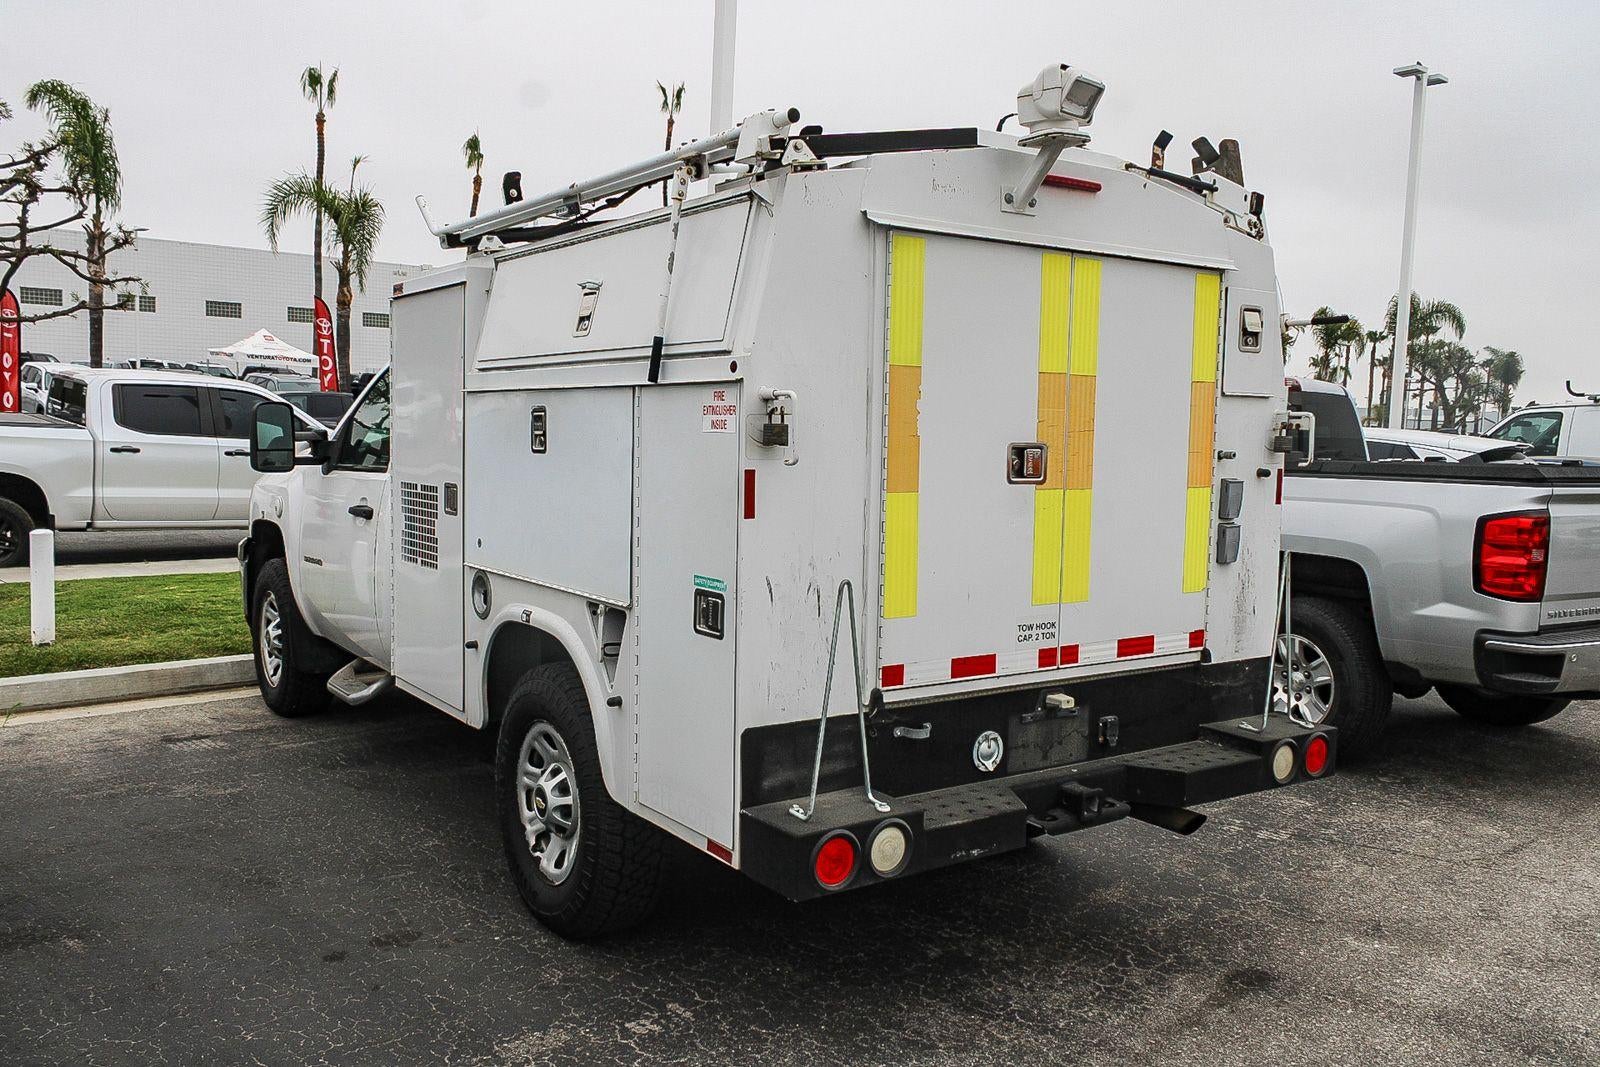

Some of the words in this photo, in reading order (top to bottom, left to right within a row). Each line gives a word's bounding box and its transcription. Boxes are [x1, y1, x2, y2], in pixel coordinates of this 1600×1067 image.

[246, 354, 312, 363] VENTURATOYOTA.COM
[320, 339, 333, 389] TOY
[2, 332, 14, 409] TOYO
[713, 390, 726, 401] FIRE
[703, 405, 737, 416] EXTINGUISHER
[711, 419, 728, 430] INSIDE
[1017, 623, 1034, 632] TOW
[1036, 621, 1056, 631] HOOK
[1017, 634, 1034, 643] CAP.
[1035, 633, 1040, 641] 2
[1041, 631, 1056, 640] TON
